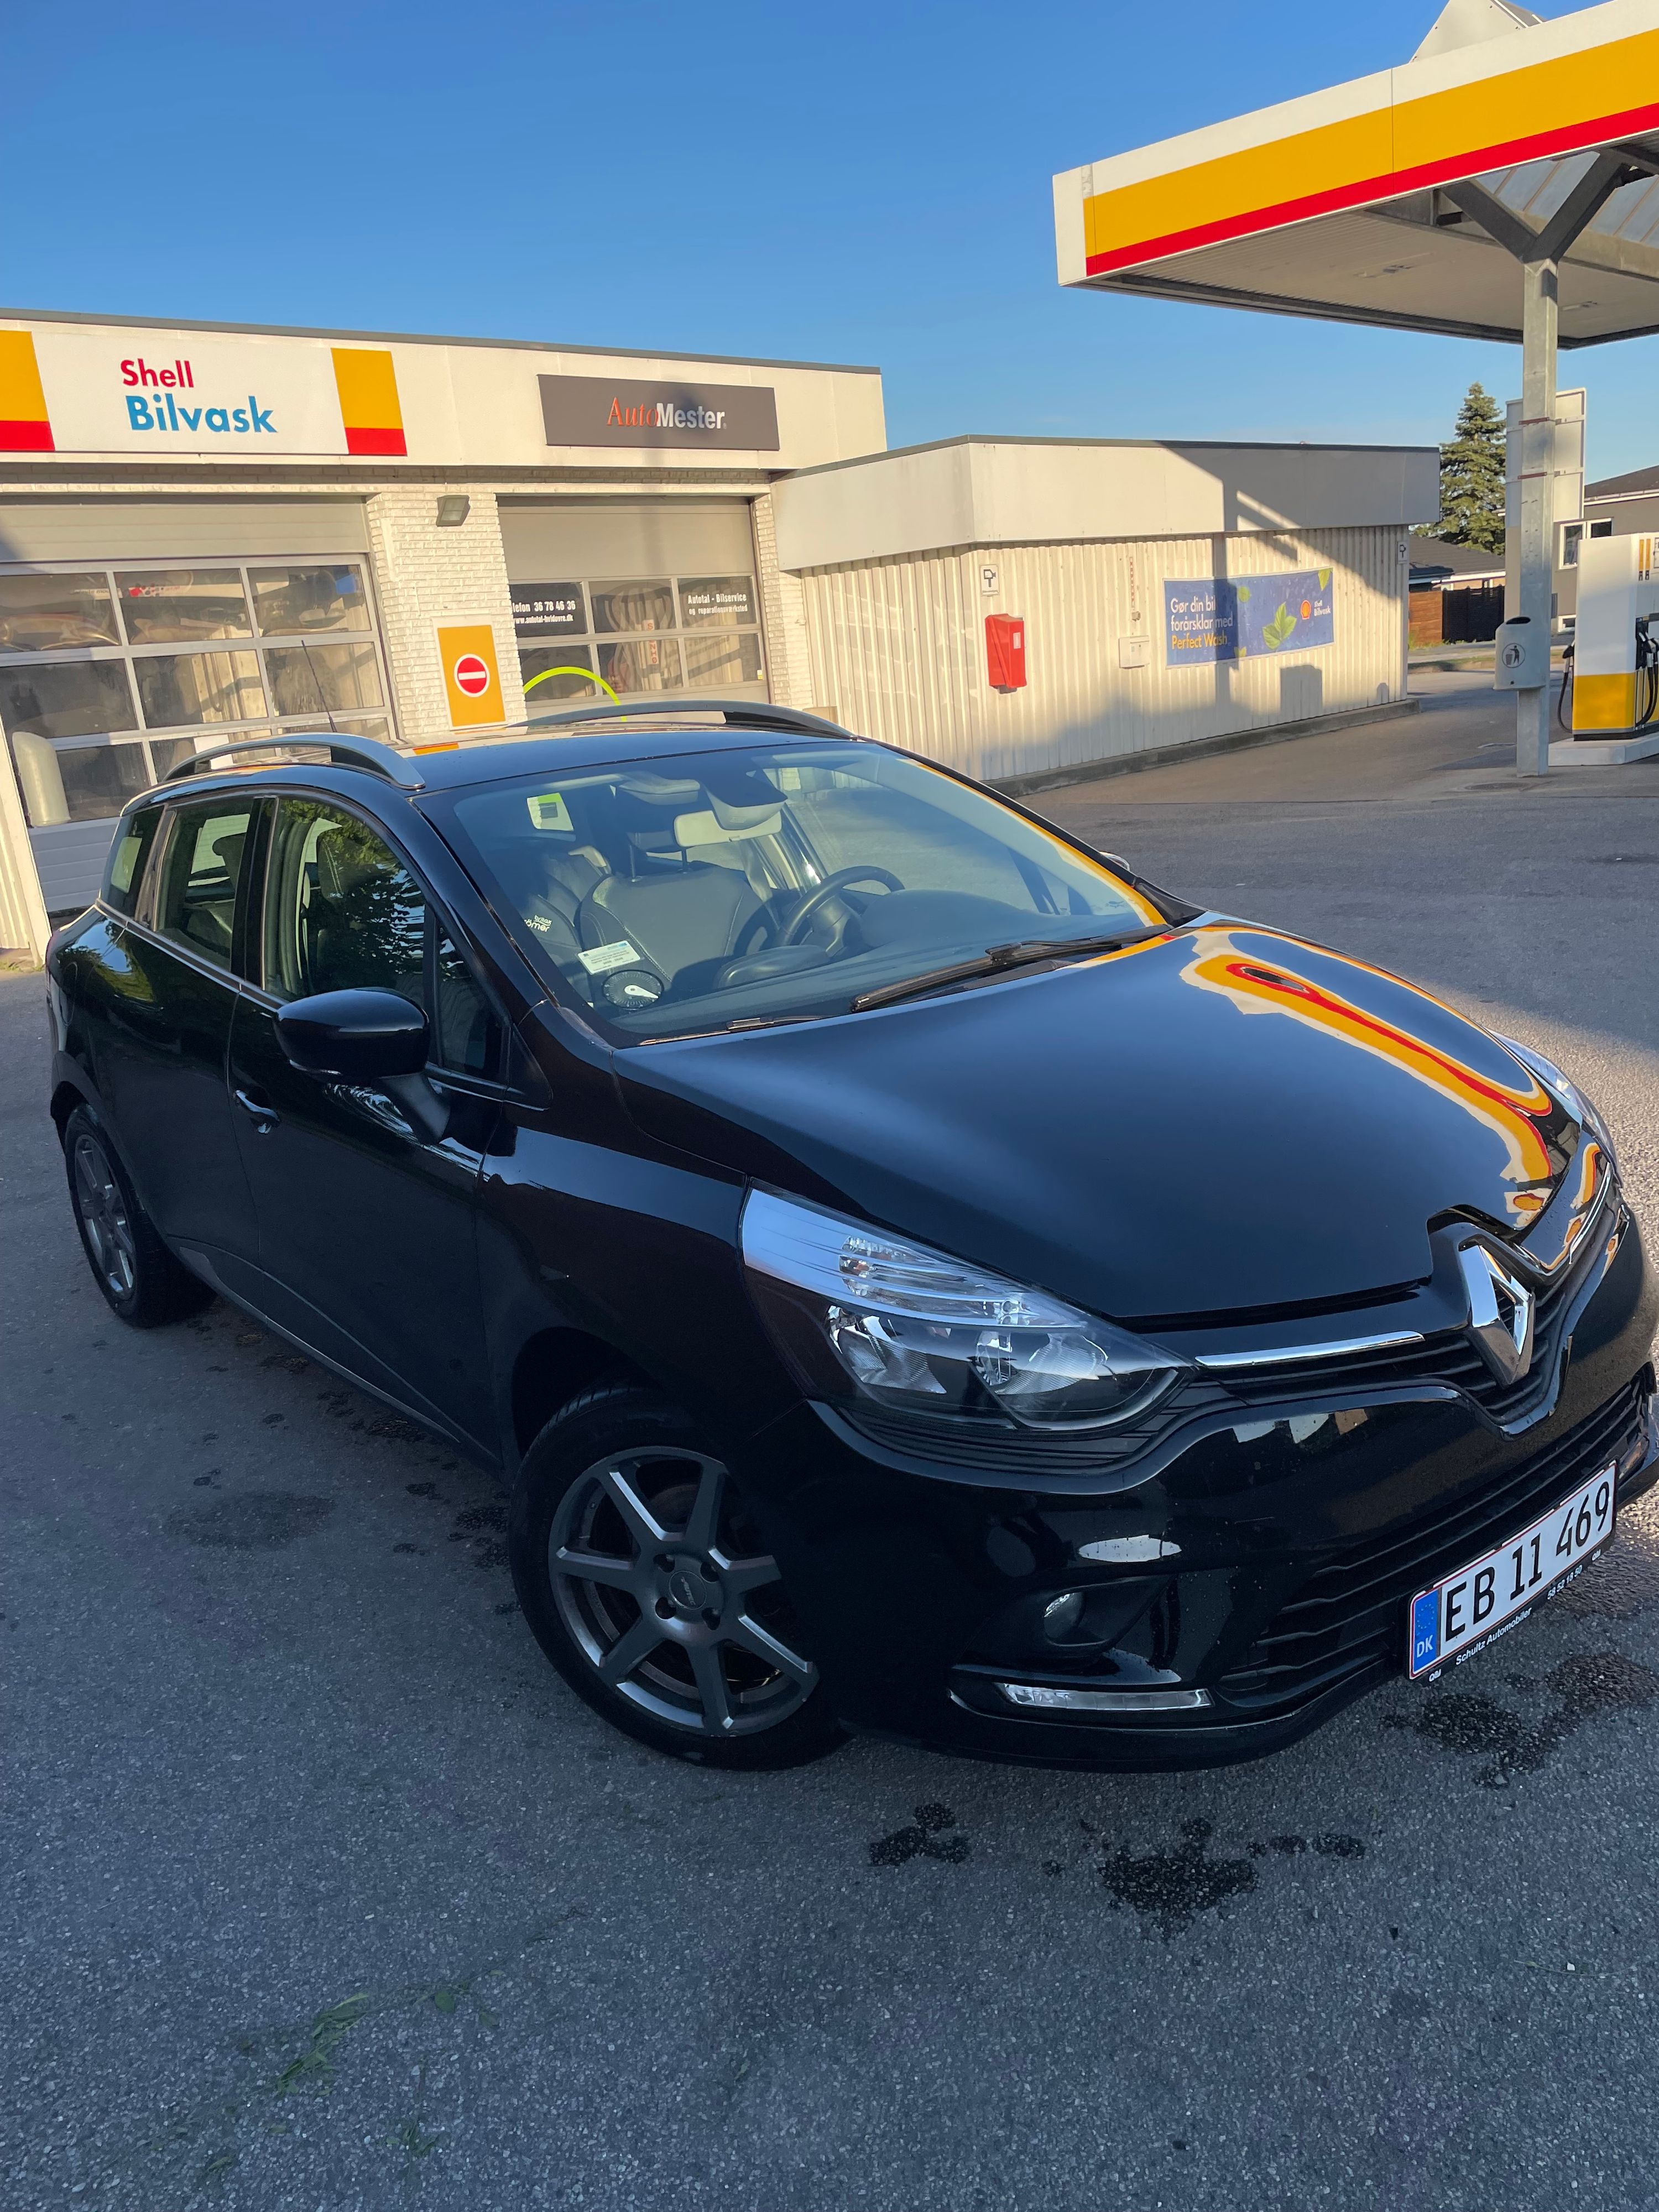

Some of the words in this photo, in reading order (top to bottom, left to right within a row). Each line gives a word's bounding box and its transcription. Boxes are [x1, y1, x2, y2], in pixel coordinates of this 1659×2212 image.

[121, 358, 195, 388] Shell
[126, 393, 278, 433] Bilvask
[607, 397, 726, 429] AutoMester
[534, 601, 544, 612] 36
[544, 601, 554, 611] 78
[556, 601, 565, 611] 46
[566, 600, 576, 610] 36
[688, 594, 710, 604] Autotal
[716, 593, 747, 603] Bilservice
[1170, 598, 1188, 613] Gør
[1190, 596, 1204, 612] din
[1205, 592, 1216, 611] bil
[1171, 613, 1213, 631] forårsklar
[1215, 611, 1233, 628] med
[1171, 632, 1202, 650] Perfect
[1203, 629, 1228, 647] Wash
[524, 919, 550, 932] ömer
[1445, 1566, 1495, 1642] EB
[1510, 1532, 1542, 1601] 11
[1555, 1481, 1610, 1557] 469
[1416, 1635, 1433, 1658] DK
[1455, 1640, 1486, 1665] Schultz
[1486, 1607, 1532, 1646] Automobiler
